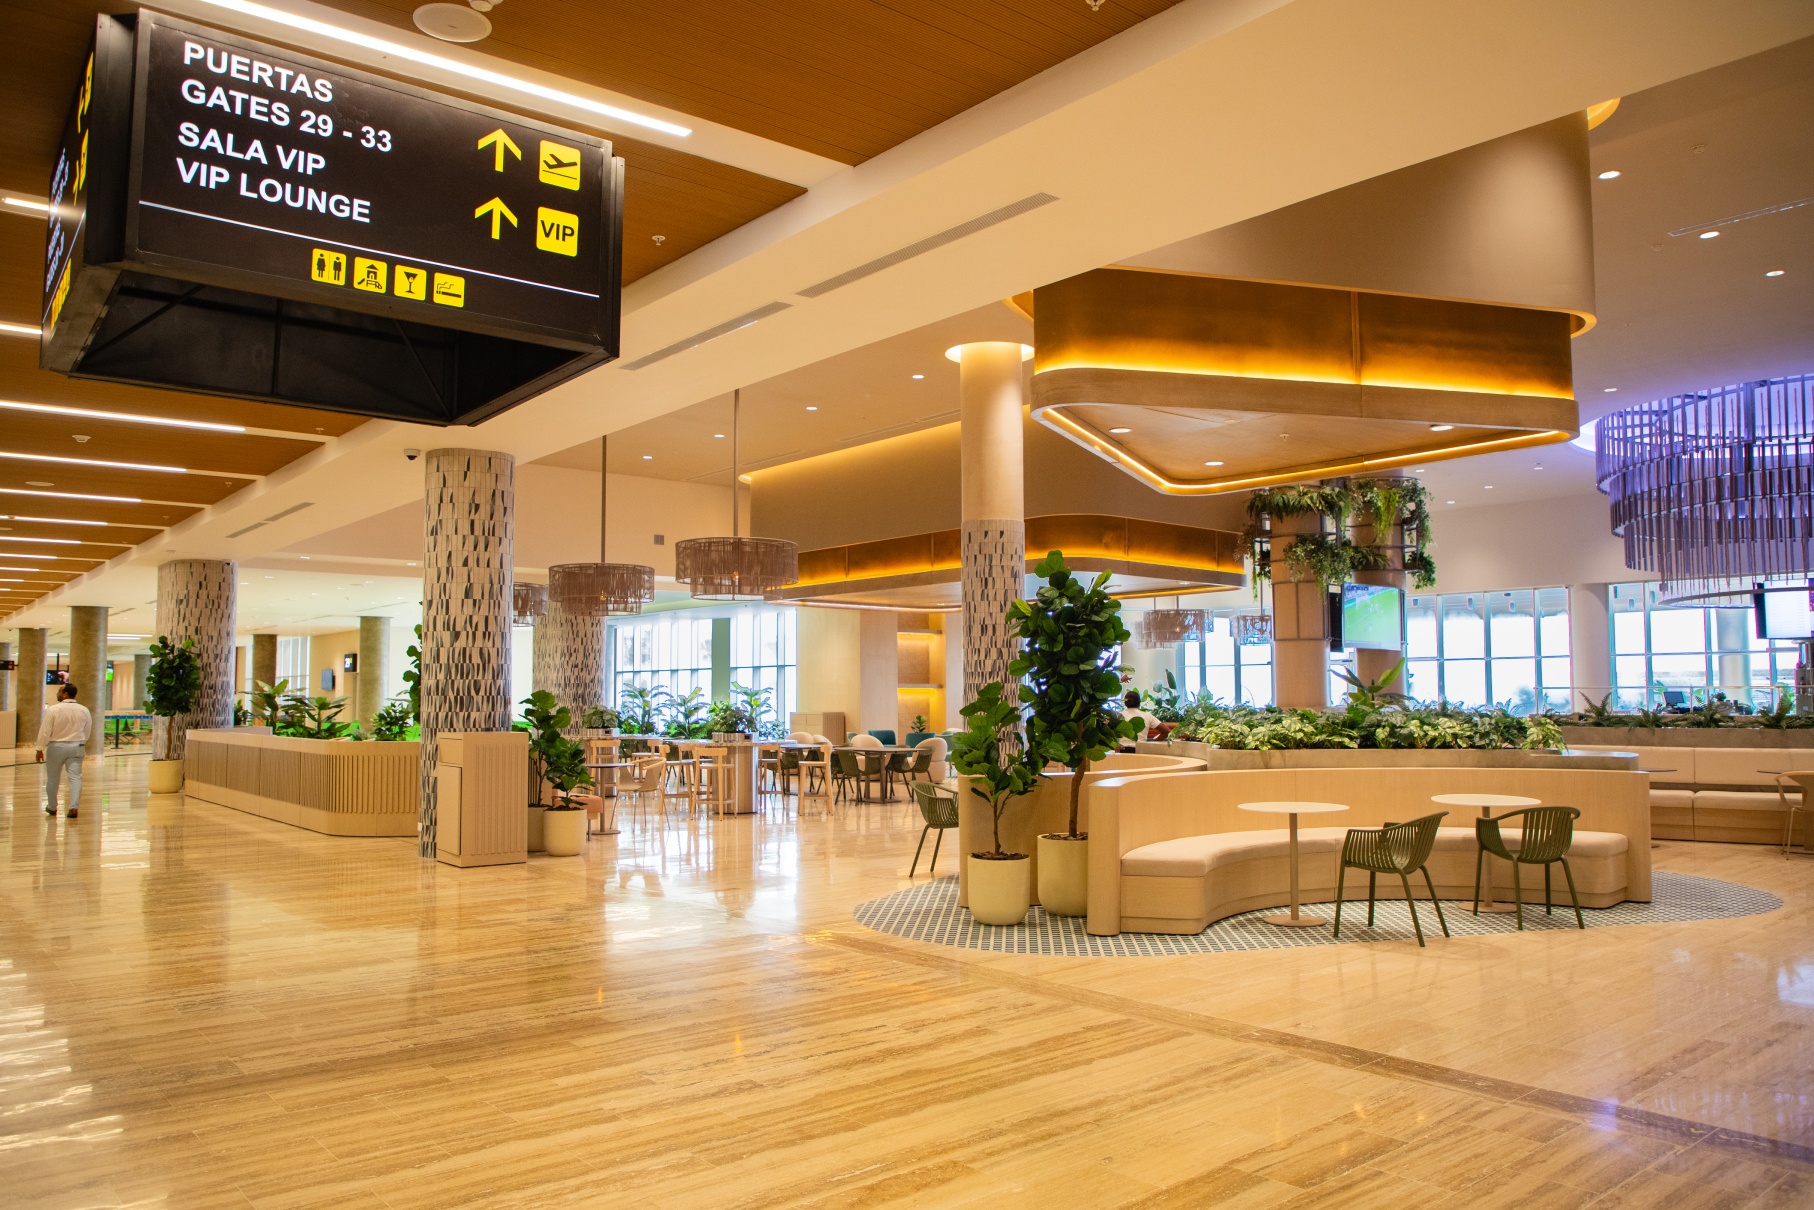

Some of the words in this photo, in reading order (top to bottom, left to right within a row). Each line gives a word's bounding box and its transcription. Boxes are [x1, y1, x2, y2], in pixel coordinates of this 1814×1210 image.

[183, 40, 333, 103] PUERTAS
[181, 78, 290, 127] GATES
[299, 109, 333, 138] 29
[342, 130, 353, 138] -
[360, 125, 393, 152] 33
[178, 121, 268, 165] SALA
[275, 144, 326, 175] VIP
[176, 157, 230, 189] VIP
[239, 172, 371, 223] LOUNGE
[540, 219, 574, 242] VIP
